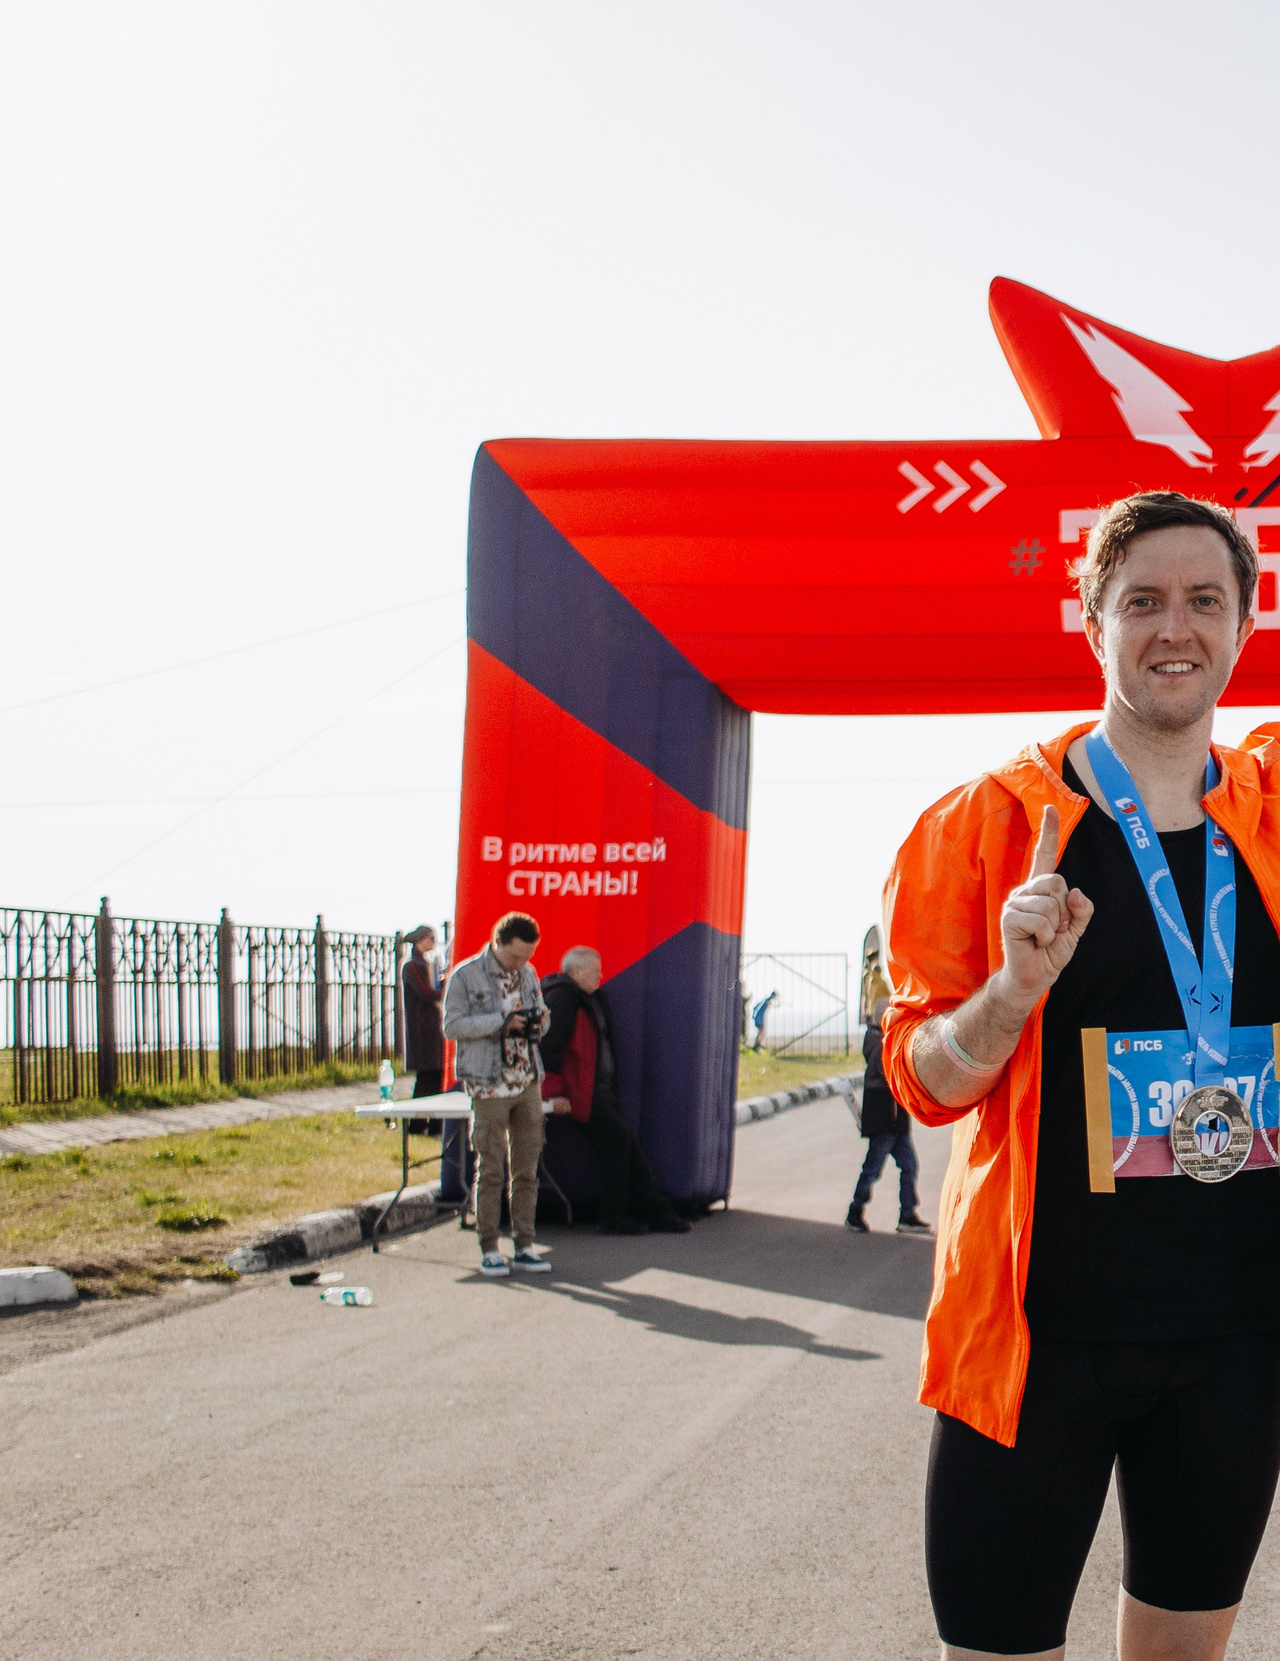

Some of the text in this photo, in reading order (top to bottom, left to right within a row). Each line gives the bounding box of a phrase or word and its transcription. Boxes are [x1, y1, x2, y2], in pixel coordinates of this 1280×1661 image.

[1127, 815, 1151, 850] ПСБ
[483, 836, 667, 866] В ритме всей
[507, 870, 639, 896] СТРАНЫ!
[1134, 1040, 1163, 1052] ПСБ
